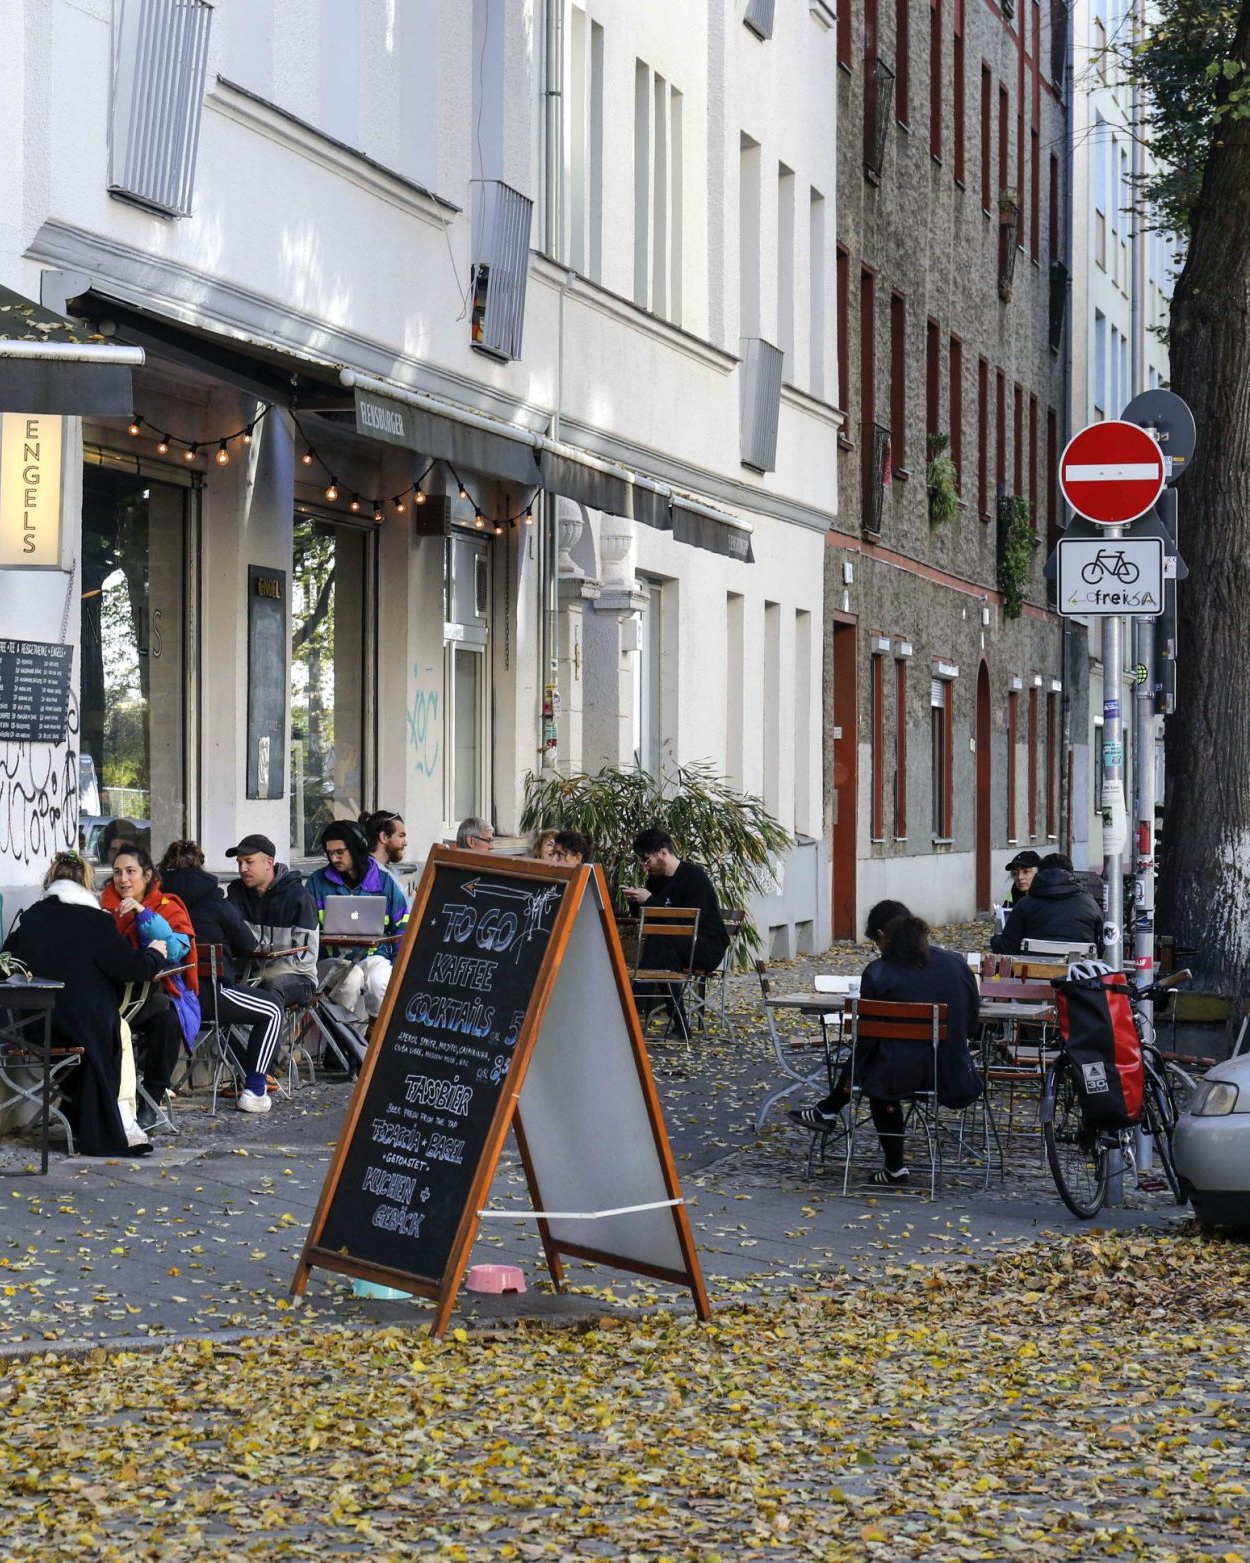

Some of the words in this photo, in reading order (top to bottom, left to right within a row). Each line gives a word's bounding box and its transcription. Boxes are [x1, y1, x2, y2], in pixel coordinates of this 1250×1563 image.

[360, 401, 405, 437] FLENSBURGER
[22, 419, 41, 554] ENGELS
[1095, 589, 1127, 605] frei
[442, 903, 478, 943] TO
[476, 908, 518, 952] GO
[428, 952, 498, 992] KAFFEE
[425, 1132, 465, 1165] BAGEL
[361, 1166, 417, 1205] KUCHEN
[372, 1204, 426, 1239] GEBÄCK
